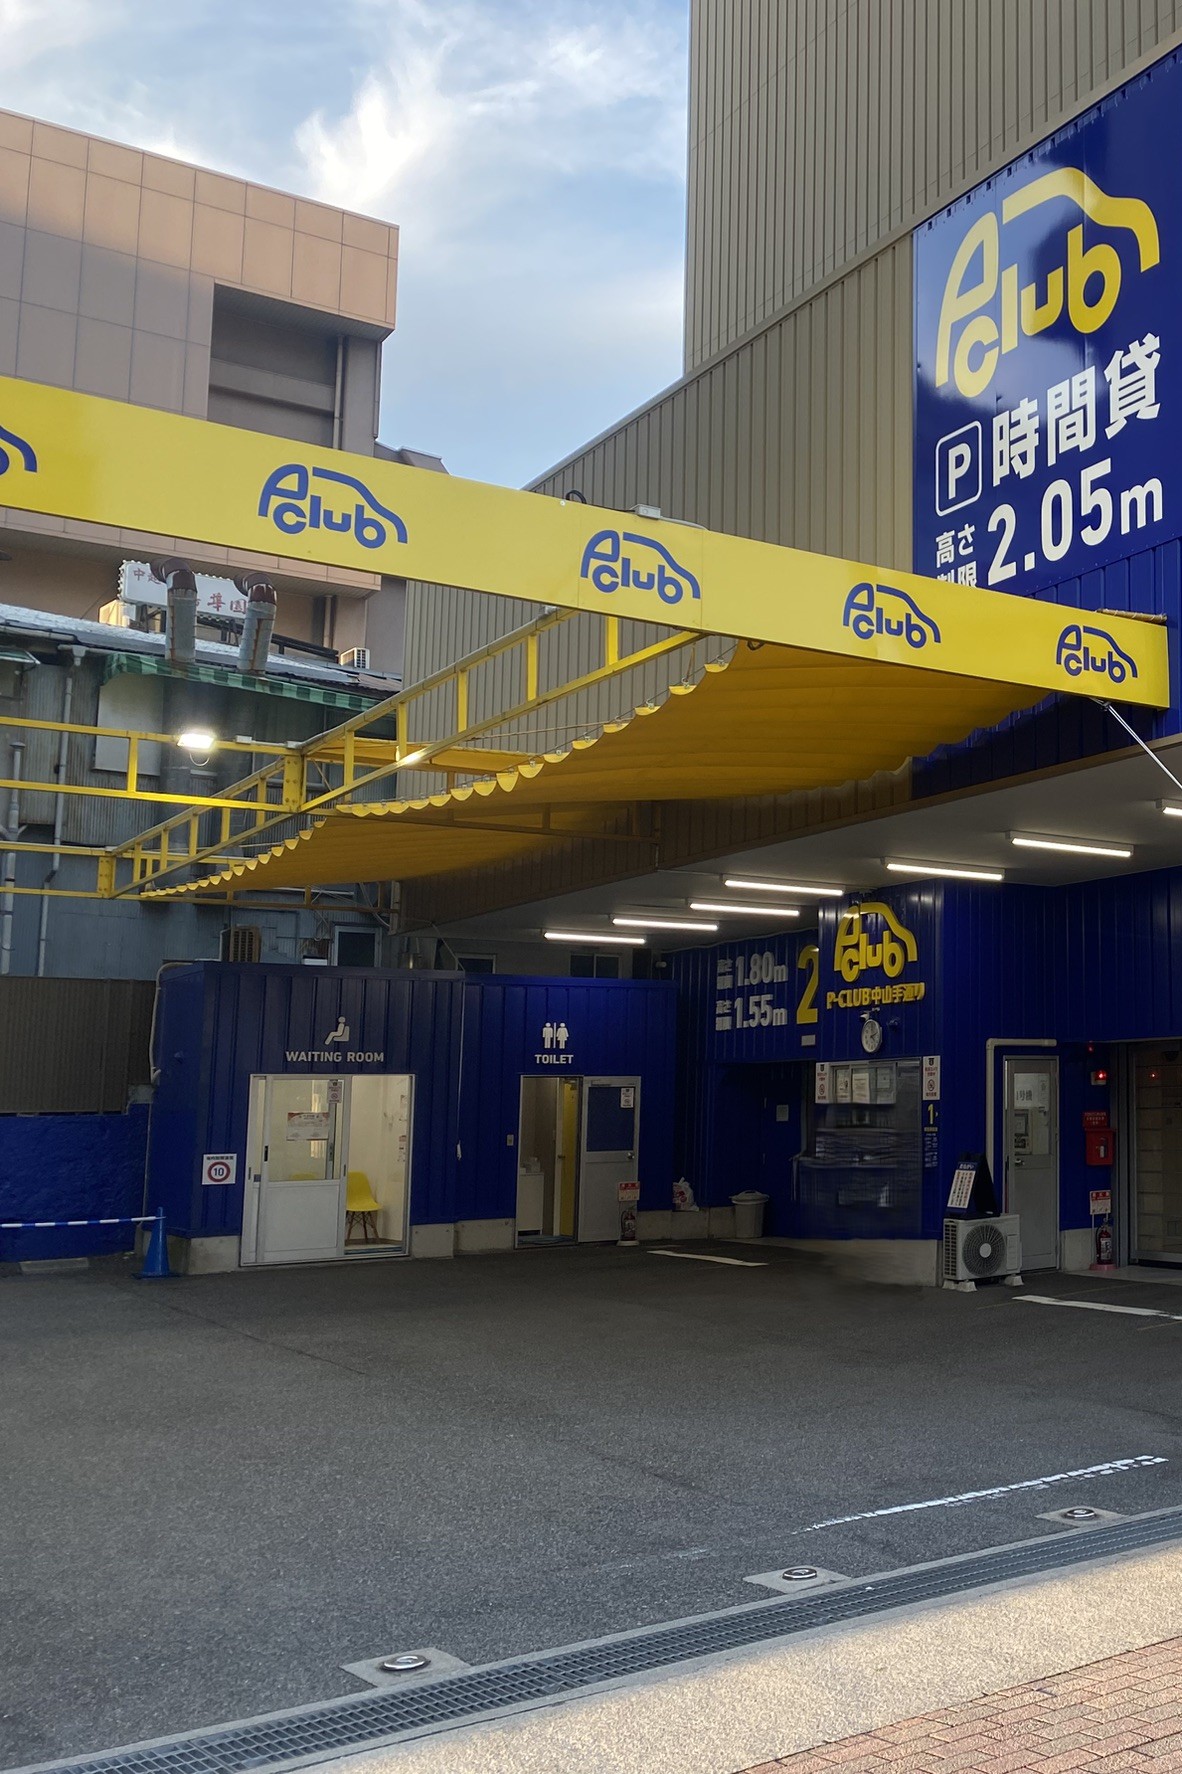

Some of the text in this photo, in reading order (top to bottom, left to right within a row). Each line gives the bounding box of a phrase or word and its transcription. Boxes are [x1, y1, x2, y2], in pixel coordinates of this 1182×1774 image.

[993, 332, 1161, 487] 時間貸
[947, 442, 970, 499] P
[987, 458, 1163, 586] 2.05m
[936, 522, 975, 568] 高さ
[735, 951, 788, 987] 1.80m
[796, 944, 819, 1024] 2
[734, 994, 788, 1029] 1.55m
[285, 1050, 384, 1063] WAITING ROOM
[534, 1054, 574, 1065] TOILET
[213, 1167, 225, 1177] 10
